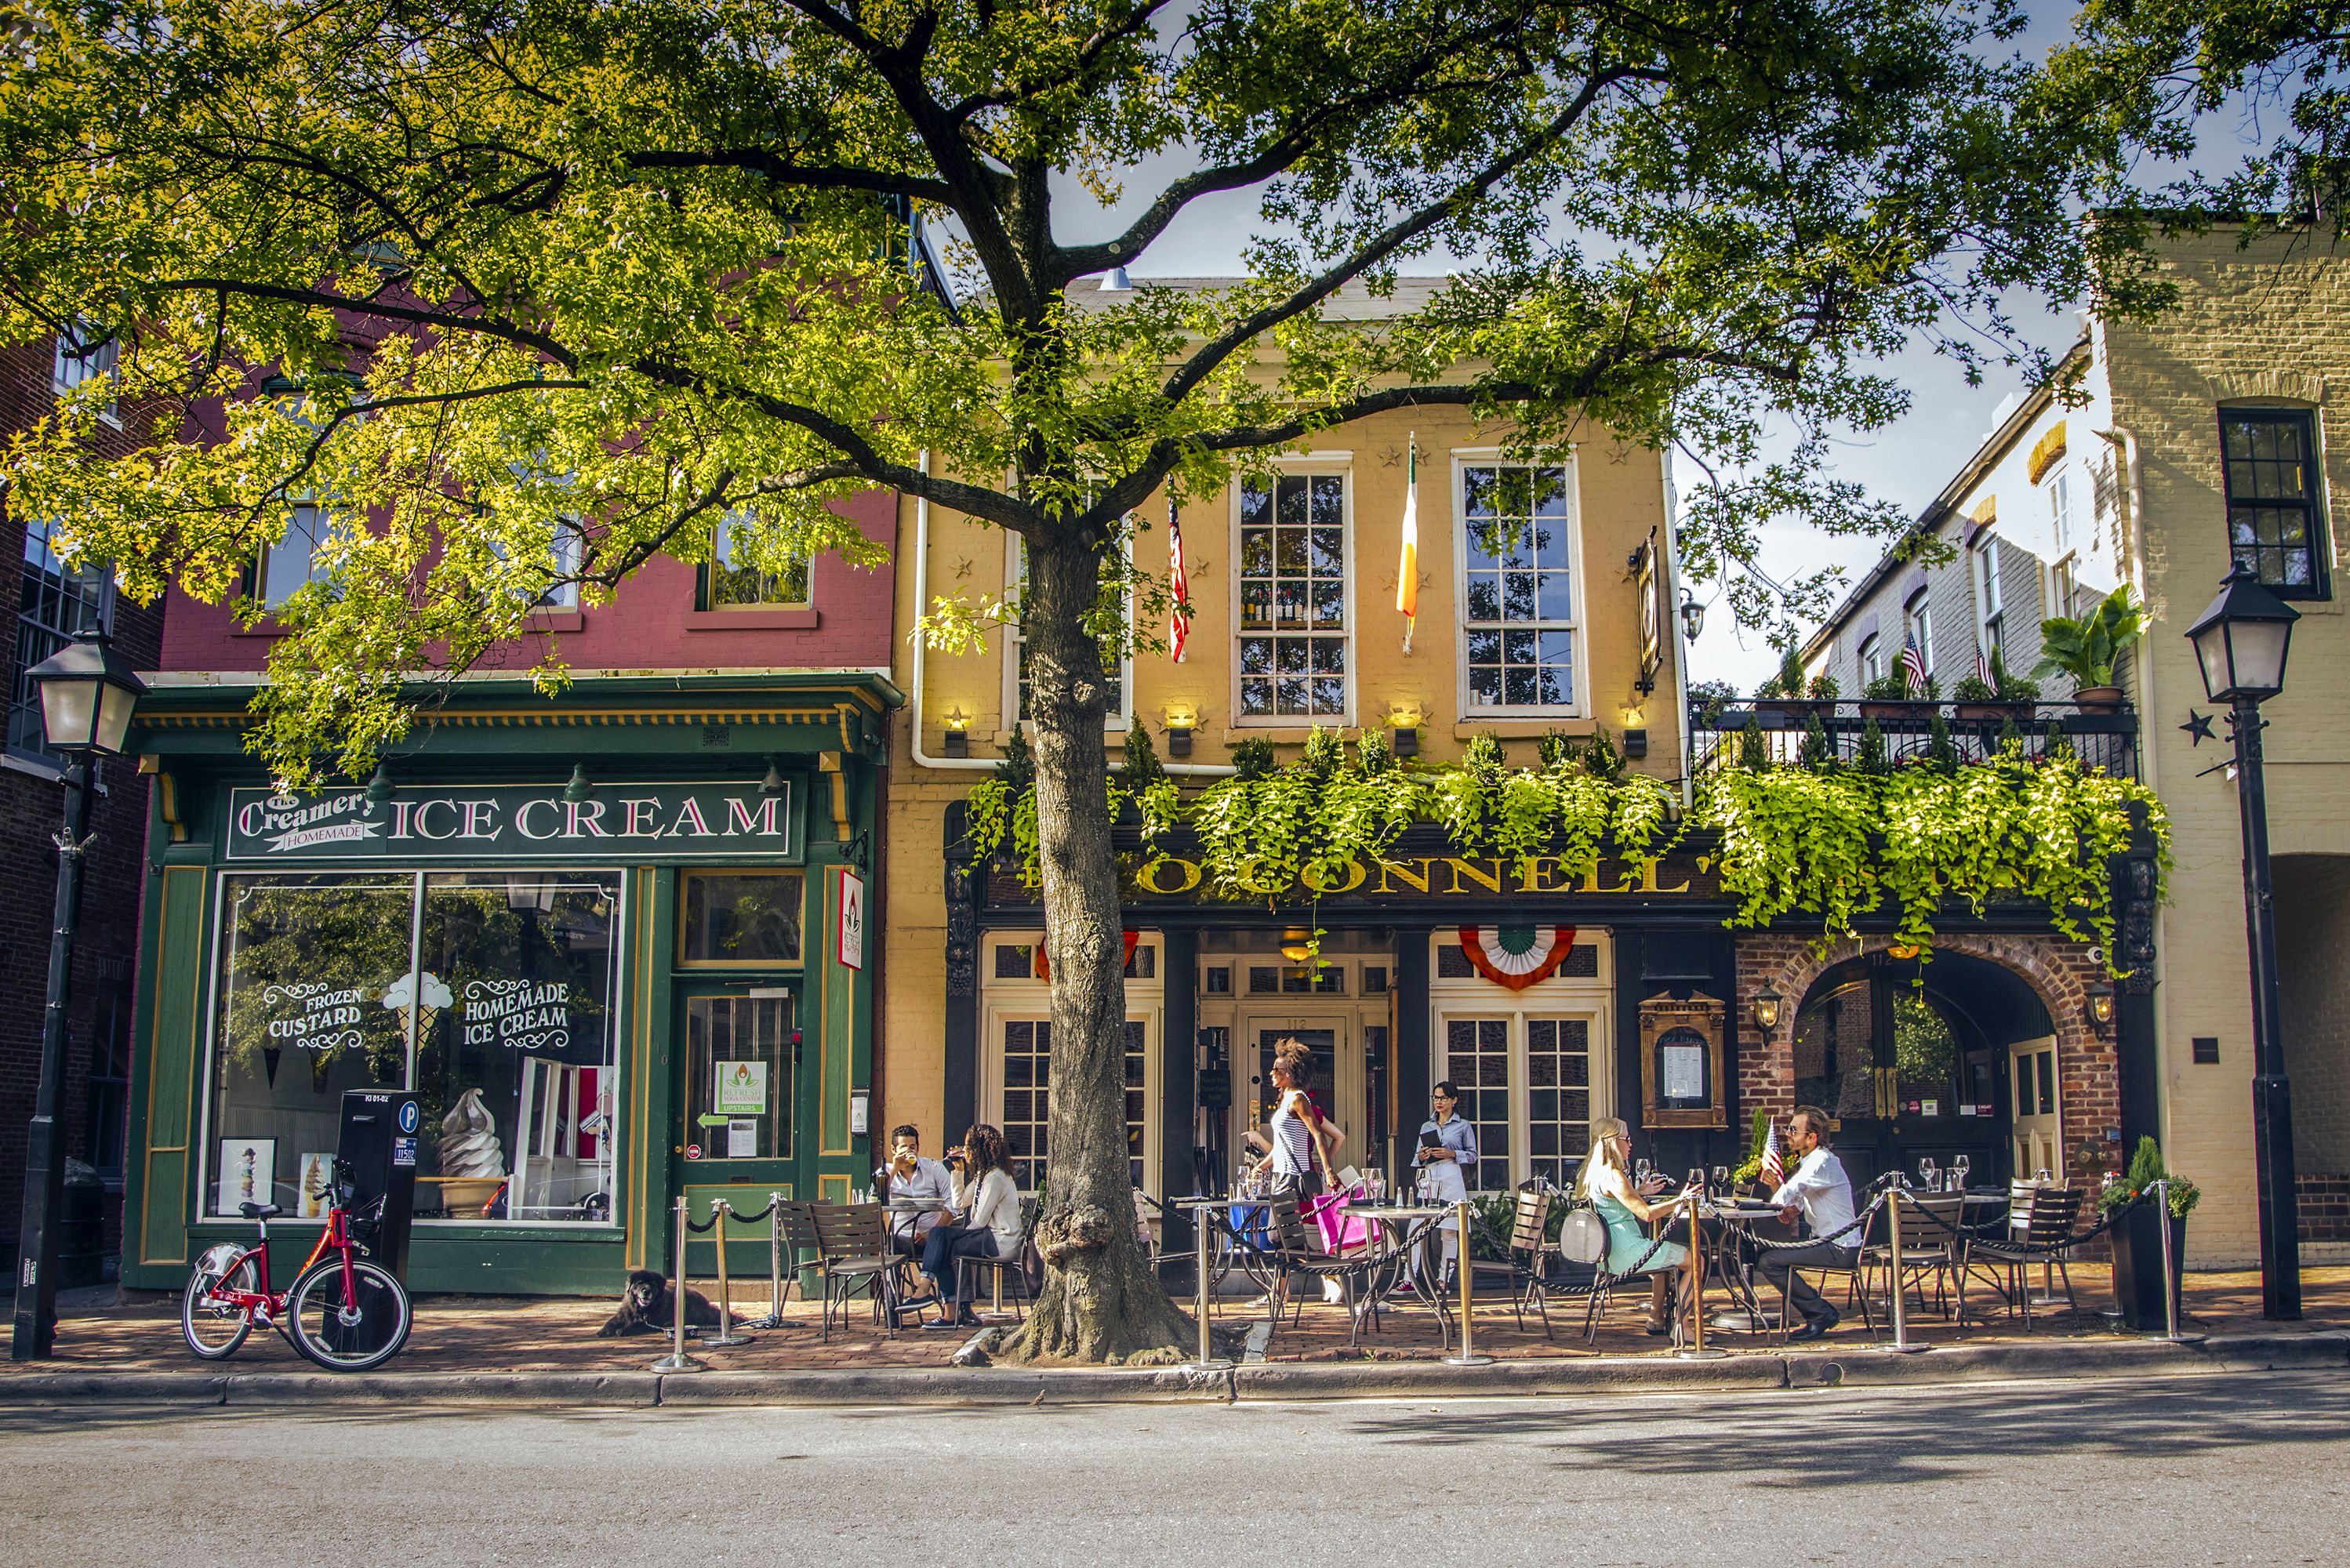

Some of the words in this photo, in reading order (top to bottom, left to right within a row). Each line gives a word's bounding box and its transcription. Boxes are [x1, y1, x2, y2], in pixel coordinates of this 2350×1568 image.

[238, 793, 376, 837] Creamery
[387, 798, 503, 842] ICE
[515, 796, 782, 840] CREAM
[288, 826, 361, 848] HOMEMADE
[305, 989, 362, 1013] FROZEN
[465, 983, 568, 1021] HOMEMADE
[269, 1007, 361, 1037] CUSTARD
[464, 1023, 495, 1045] ICE
[500, 1008, 568, 1038] CREAM
[1287, 1019, 1306, 1029] 112
[406, 1106, 415, 1127] P
[398, 1149, 414, 1159] 11502
